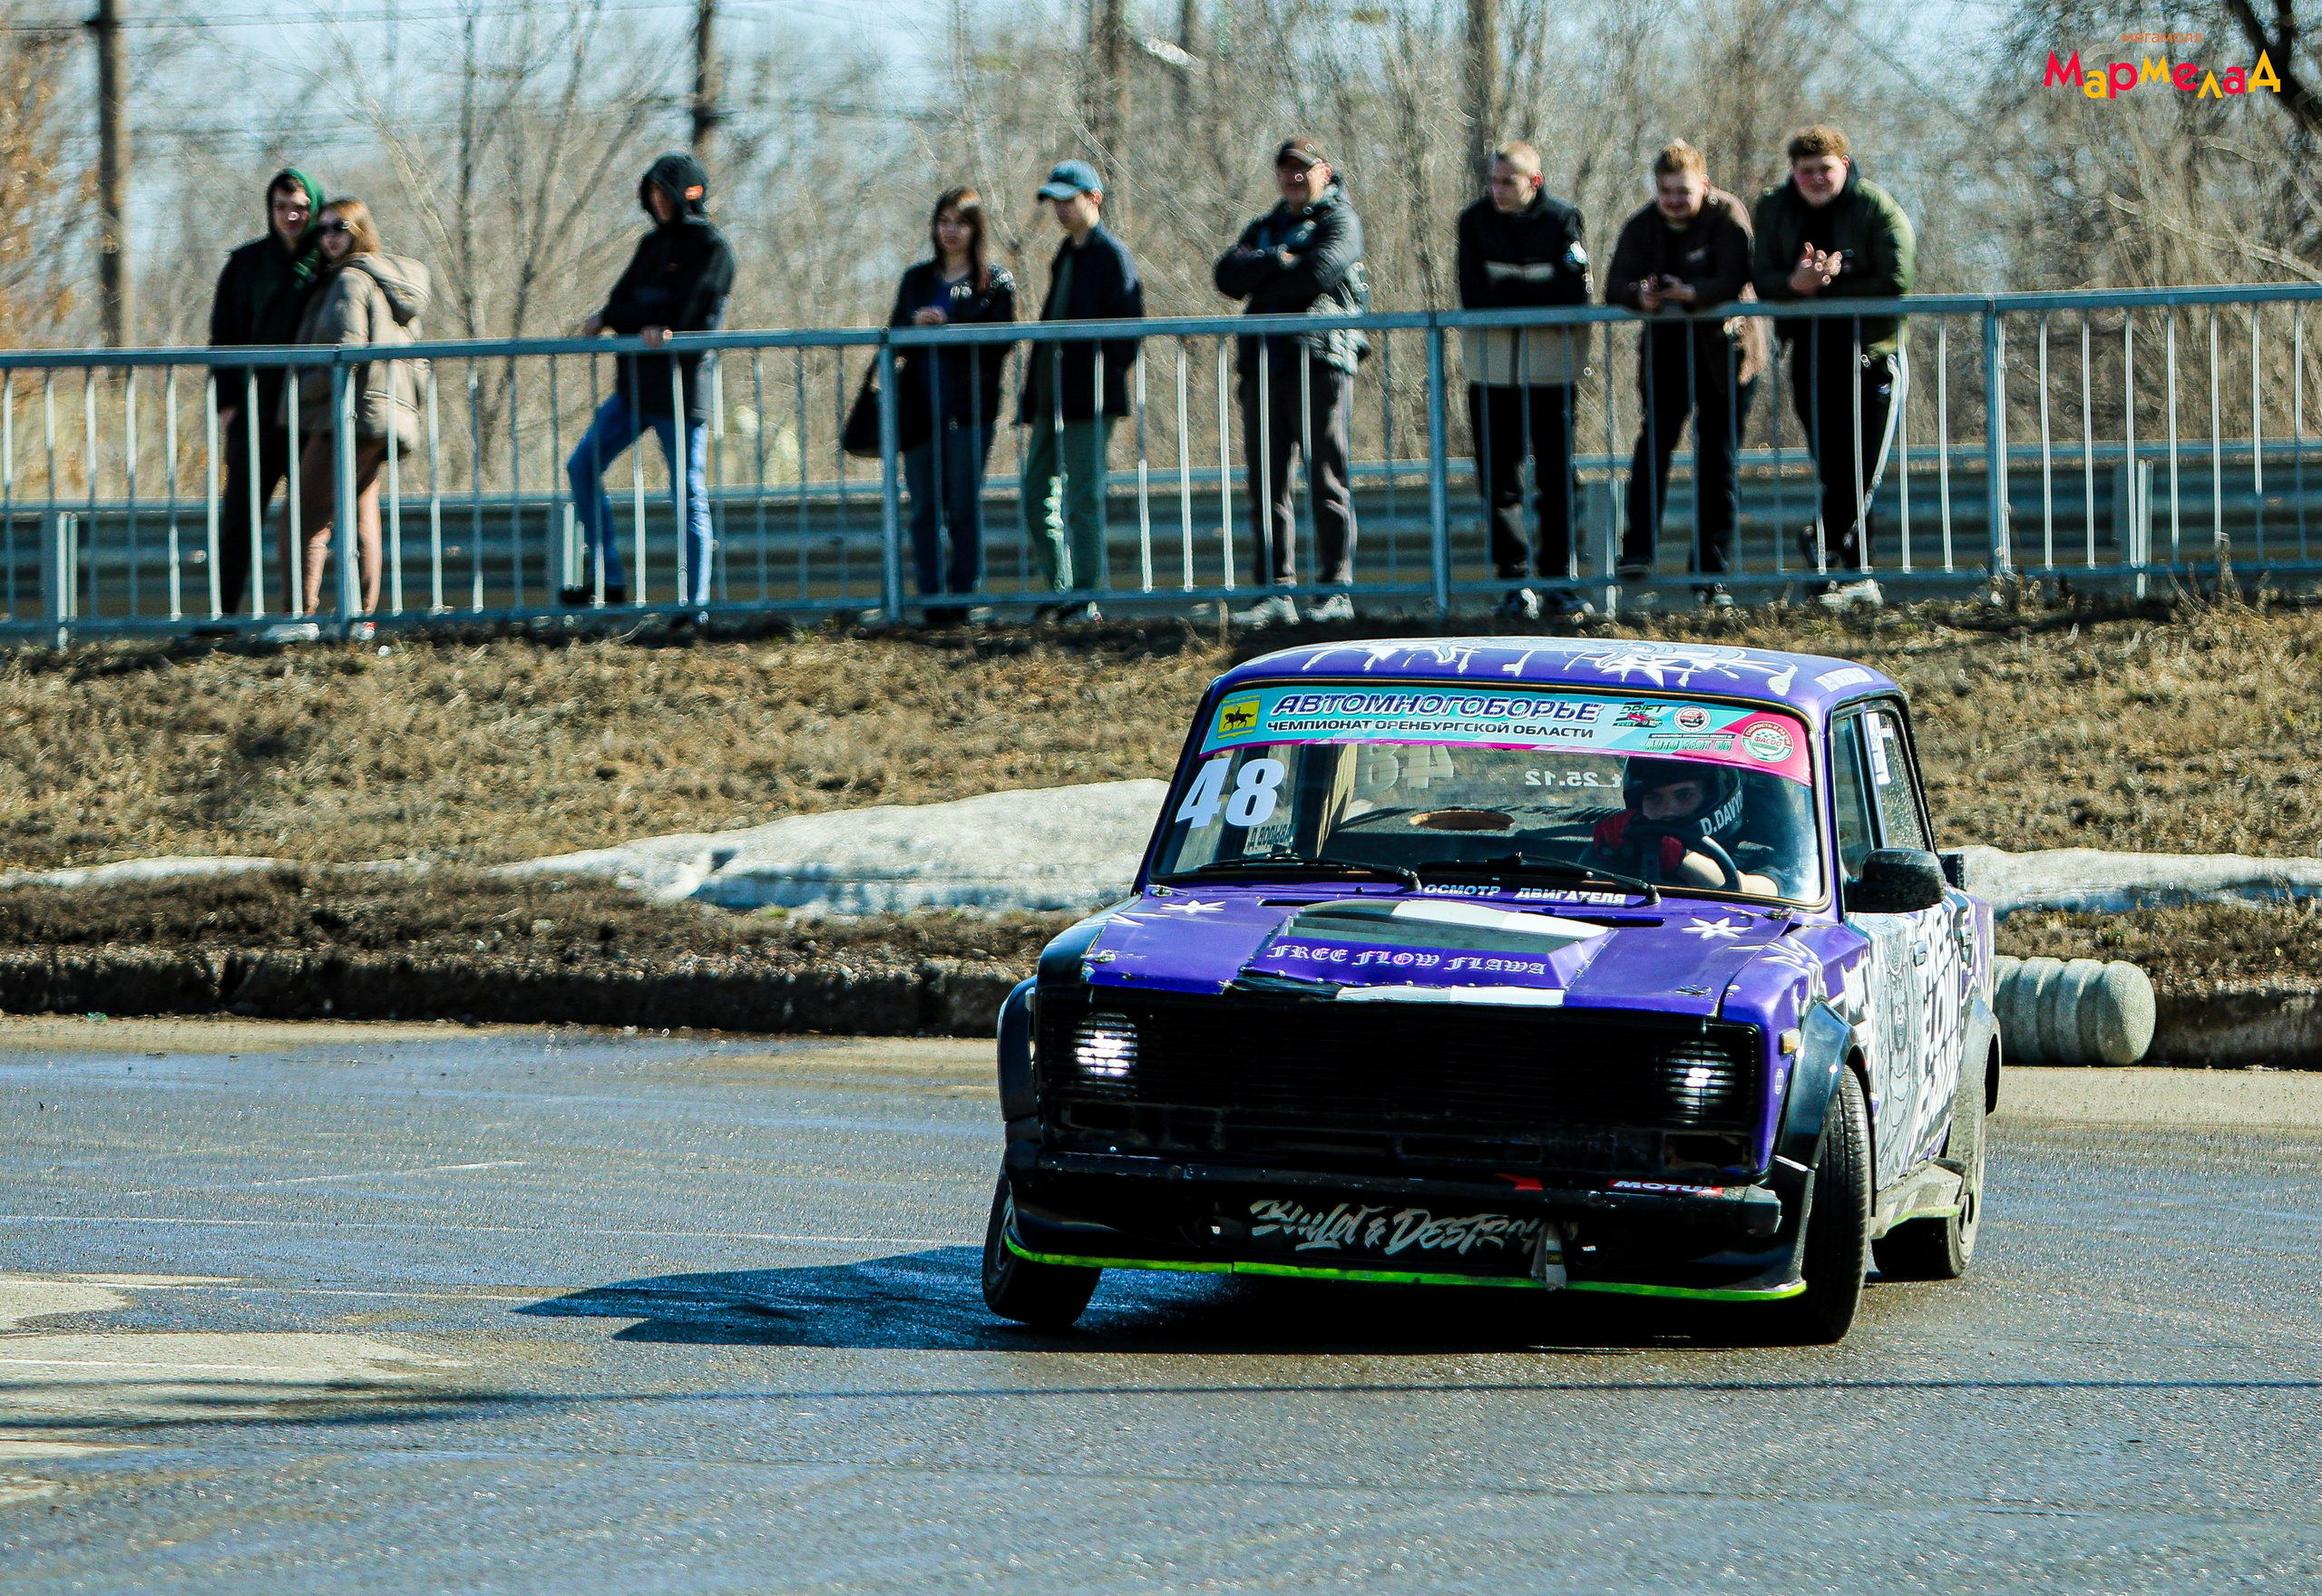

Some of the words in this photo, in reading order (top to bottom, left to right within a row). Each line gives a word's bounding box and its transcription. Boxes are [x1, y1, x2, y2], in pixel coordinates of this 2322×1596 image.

[1271, 693, 1604, 723] АВТОМНОГОБОРЬЕ
[1267, 720, 1372, 732] ЧЕМПИОНАТ
[1374, 720, 1509, 735] ОРЕНБУРГСКОЙ
[1513, 725, 1594, 739] ОБЛАСТИ
[1176, 757, 1284, 829] 48
[1700, 789, 1742, 835] D.DAVY
[1424, 884, 1501, 896] ОСМОТР
[1514, 887, 1626, 905] ДВИГАТЕЛЯ
[1266, 944, 1349, 963] FREE
[1351, 949, 1440, 968] FLOW
[1443, 957, 1546, 976] FLAWA
